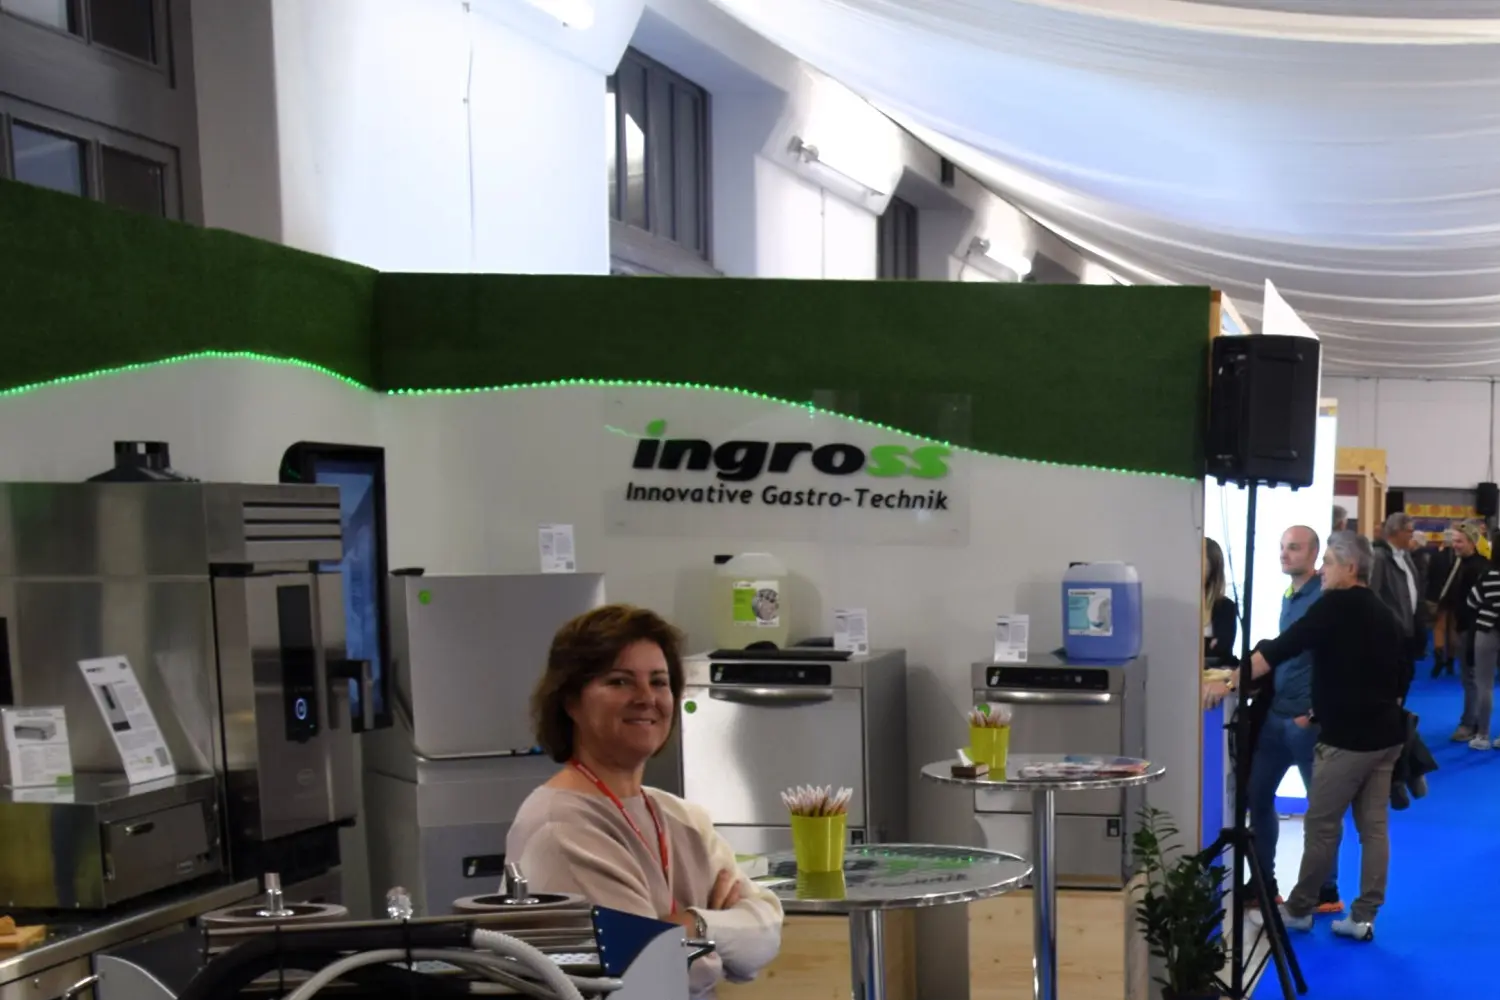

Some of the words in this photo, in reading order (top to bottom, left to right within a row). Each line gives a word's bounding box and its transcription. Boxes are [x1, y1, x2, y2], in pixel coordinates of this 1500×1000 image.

[632, 420, 952, 482] ingross
[627, 482, 753, 506] Innovative
[762, 485, 949, 510] Gastro-Technik
